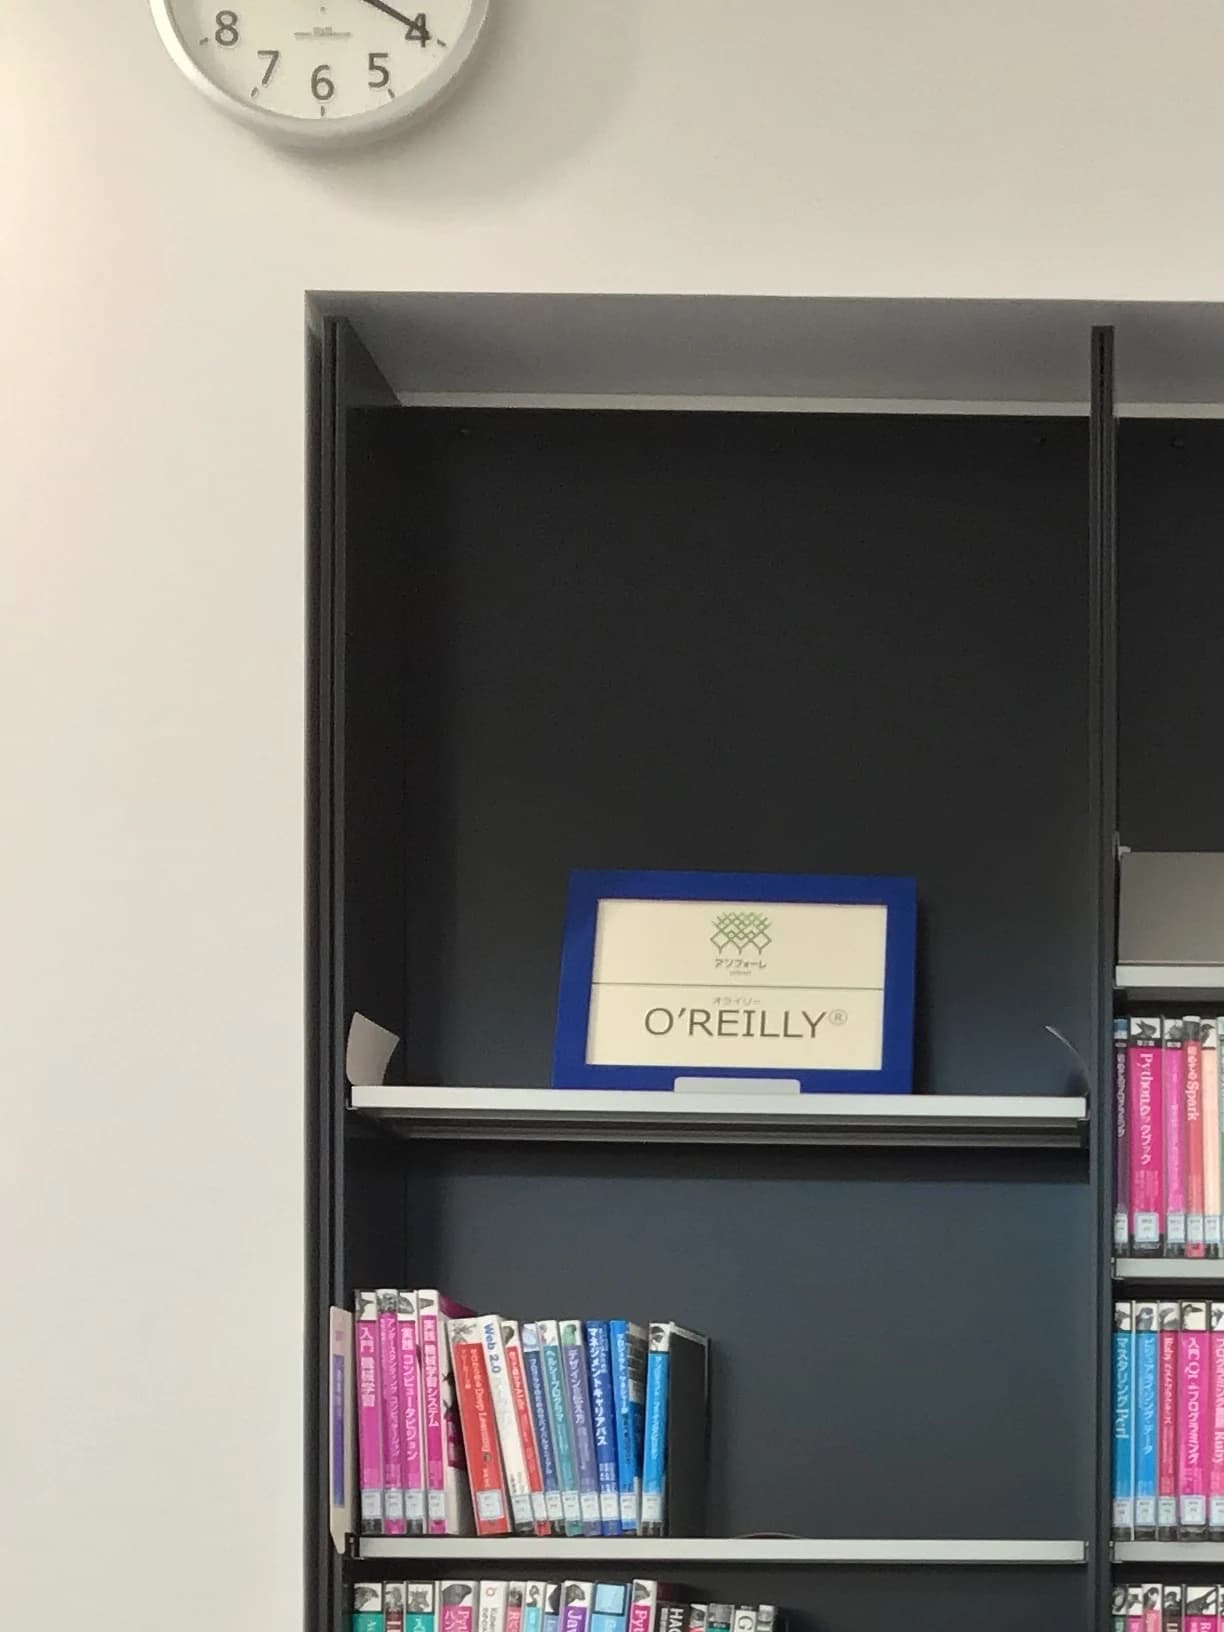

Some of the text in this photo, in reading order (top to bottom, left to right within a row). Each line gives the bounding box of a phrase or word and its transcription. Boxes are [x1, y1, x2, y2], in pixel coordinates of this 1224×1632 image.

[215, 11, 239, 46] 8
[405, 13, 430, 48] 4
[257, 50, 280, 85] 7
[311, 64, 335, 101] 6
[368, 53, 390, 88] 5
[715, 958, 767, 970] アンフォーレ
[484, 1323, 501, 1374] Web 2.0
[588, 1328, 607, 1446] マネジメントキャリアパス
[403, 1355, 418, 1461] コンピュータビジョン
